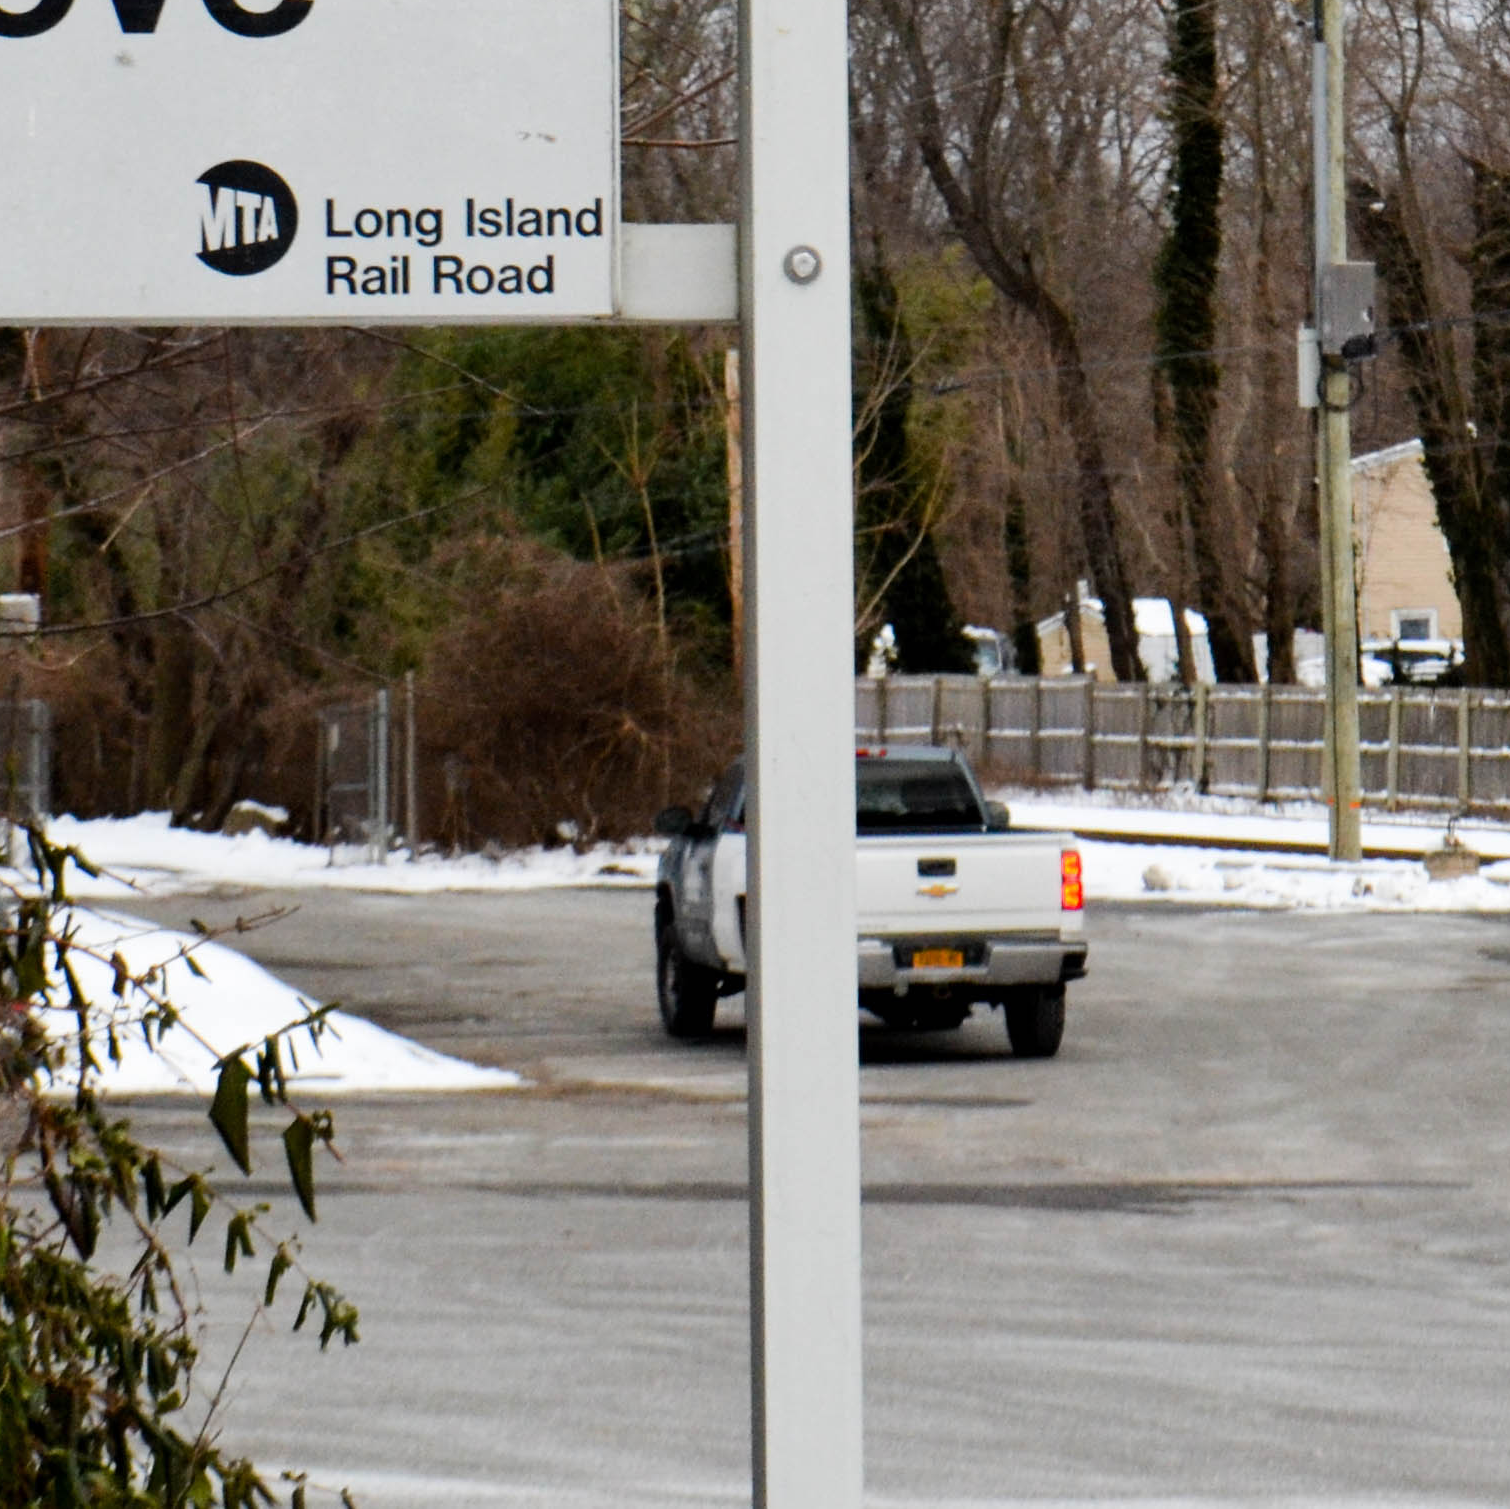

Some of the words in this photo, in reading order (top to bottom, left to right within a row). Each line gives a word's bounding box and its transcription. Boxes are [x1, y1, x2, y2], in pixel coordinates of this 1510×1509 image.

[195, 180, 286, 255] MTA
[326, 197, 444, 248] Long
[466, 197, 604, 239] Island
[326, 254, 411, 296] Rail
[433, 254, 555, 296] Road
